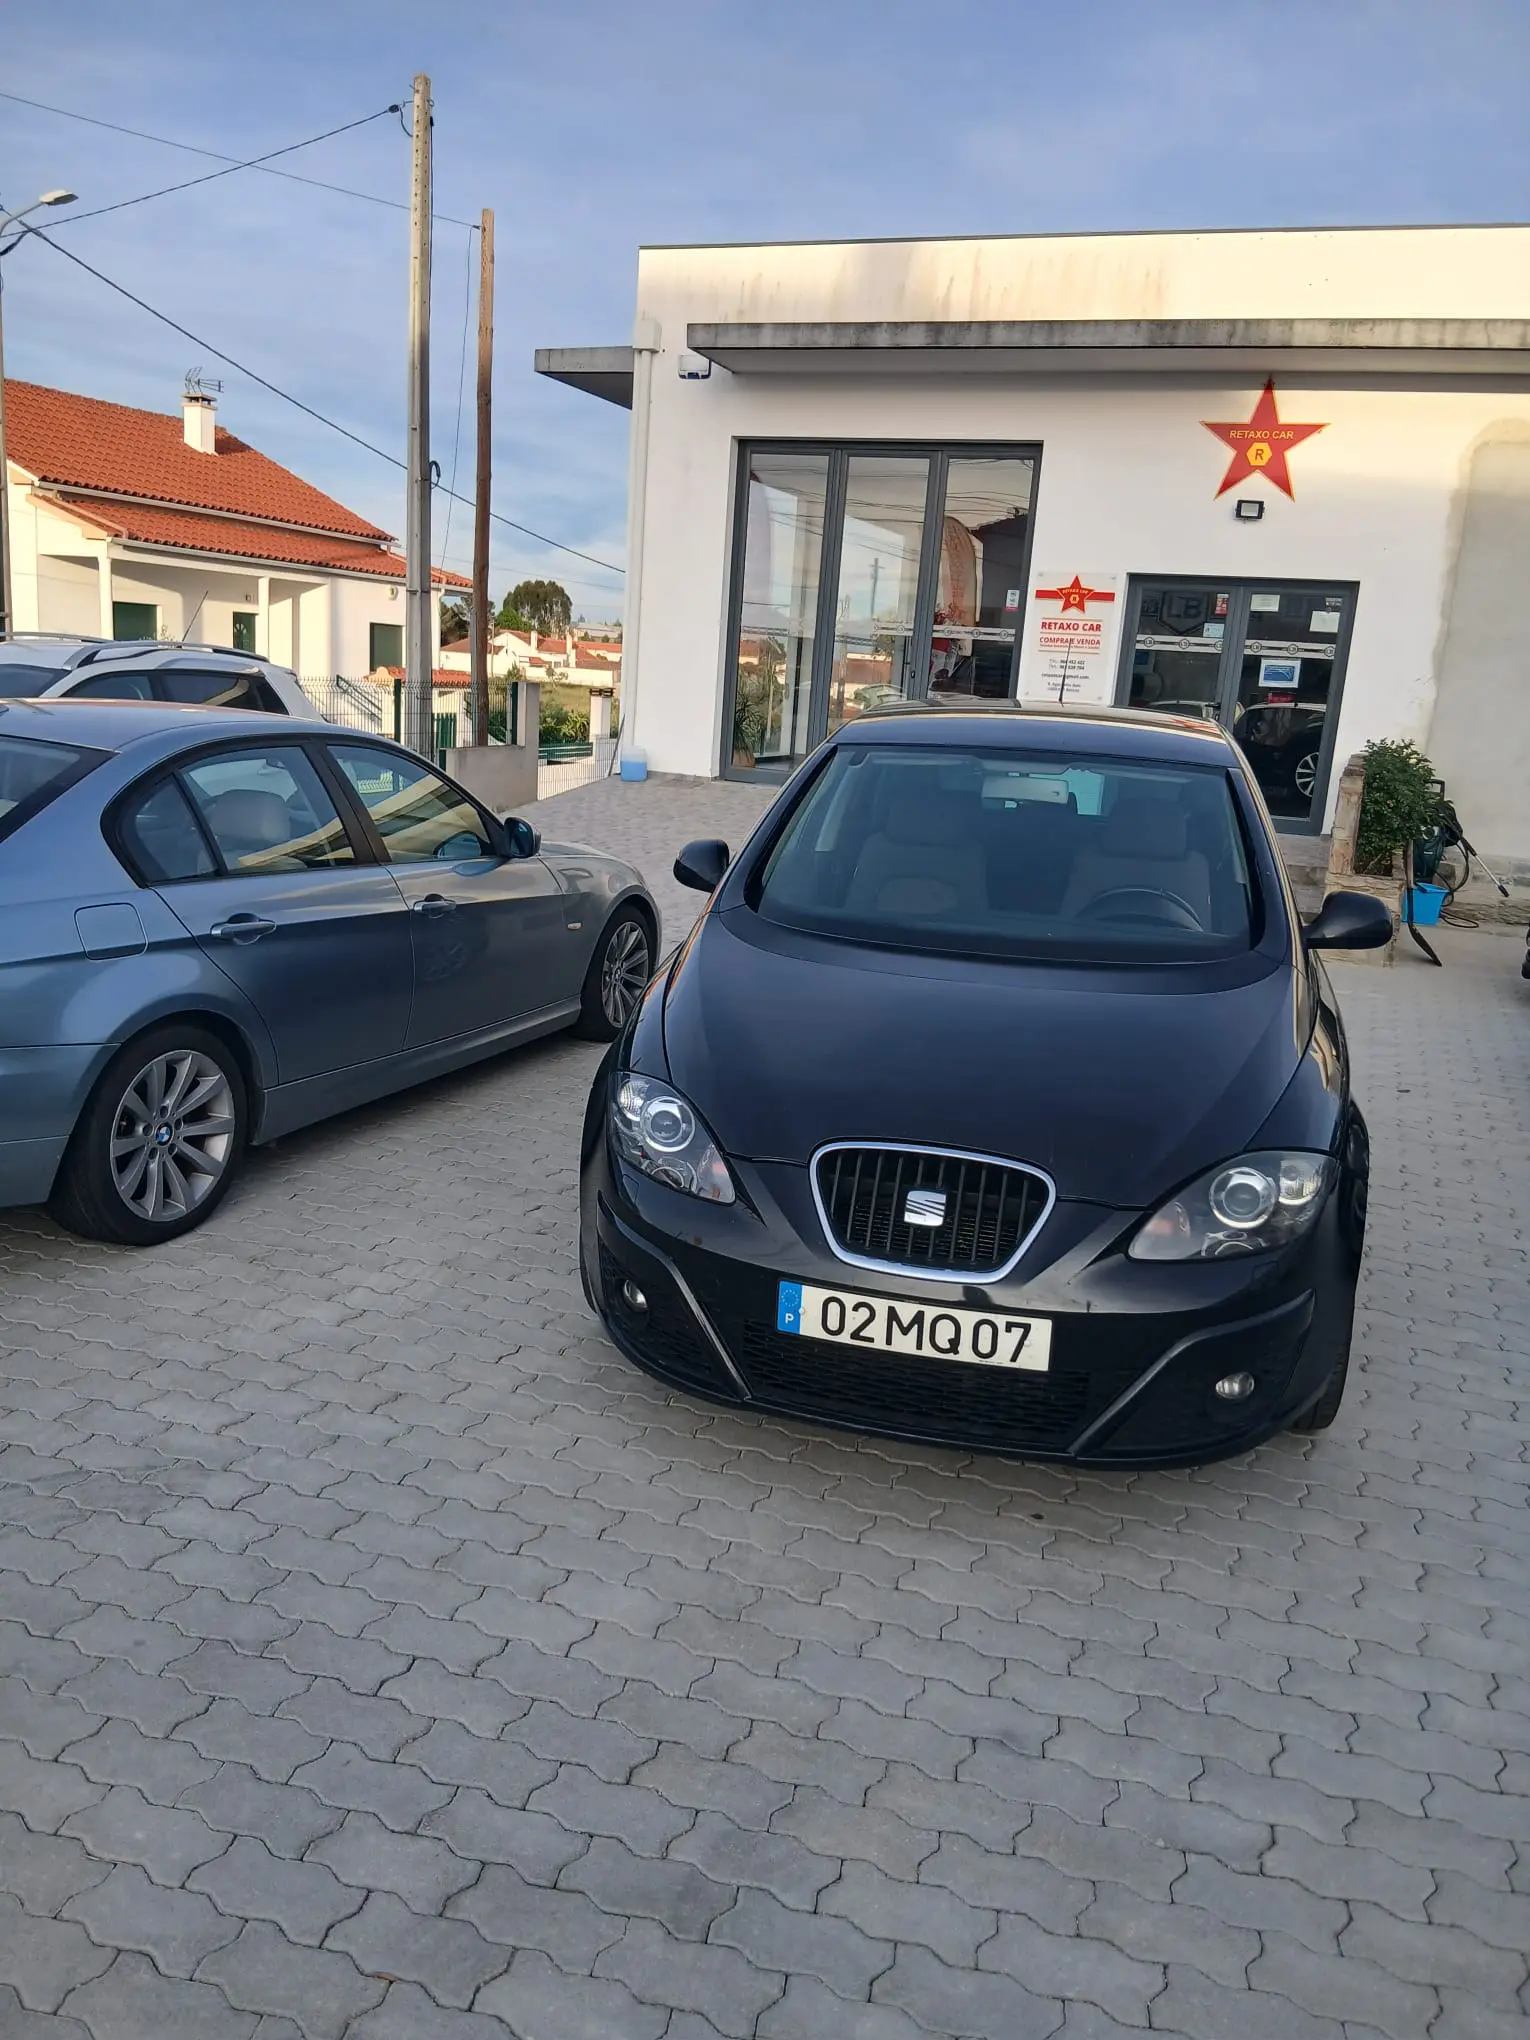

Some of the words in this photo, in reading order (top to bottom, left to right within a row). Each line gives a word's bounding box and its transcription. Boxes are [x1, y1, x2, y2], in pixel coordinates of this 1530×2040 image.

[1229, 430, 1270, 439] RETAXO
[1272, 430, 1294, 440] CAR
[1255, 448, 1264, 461] R
[1041, 621, 1079, 631] RETAXO
[1082, 623, 1102, 632] CAR
[1039, 636, 1069, 644] COMPRA
[1076, 638, 1101, 646] VENDA
[785, 1313, 794, 1324] P
